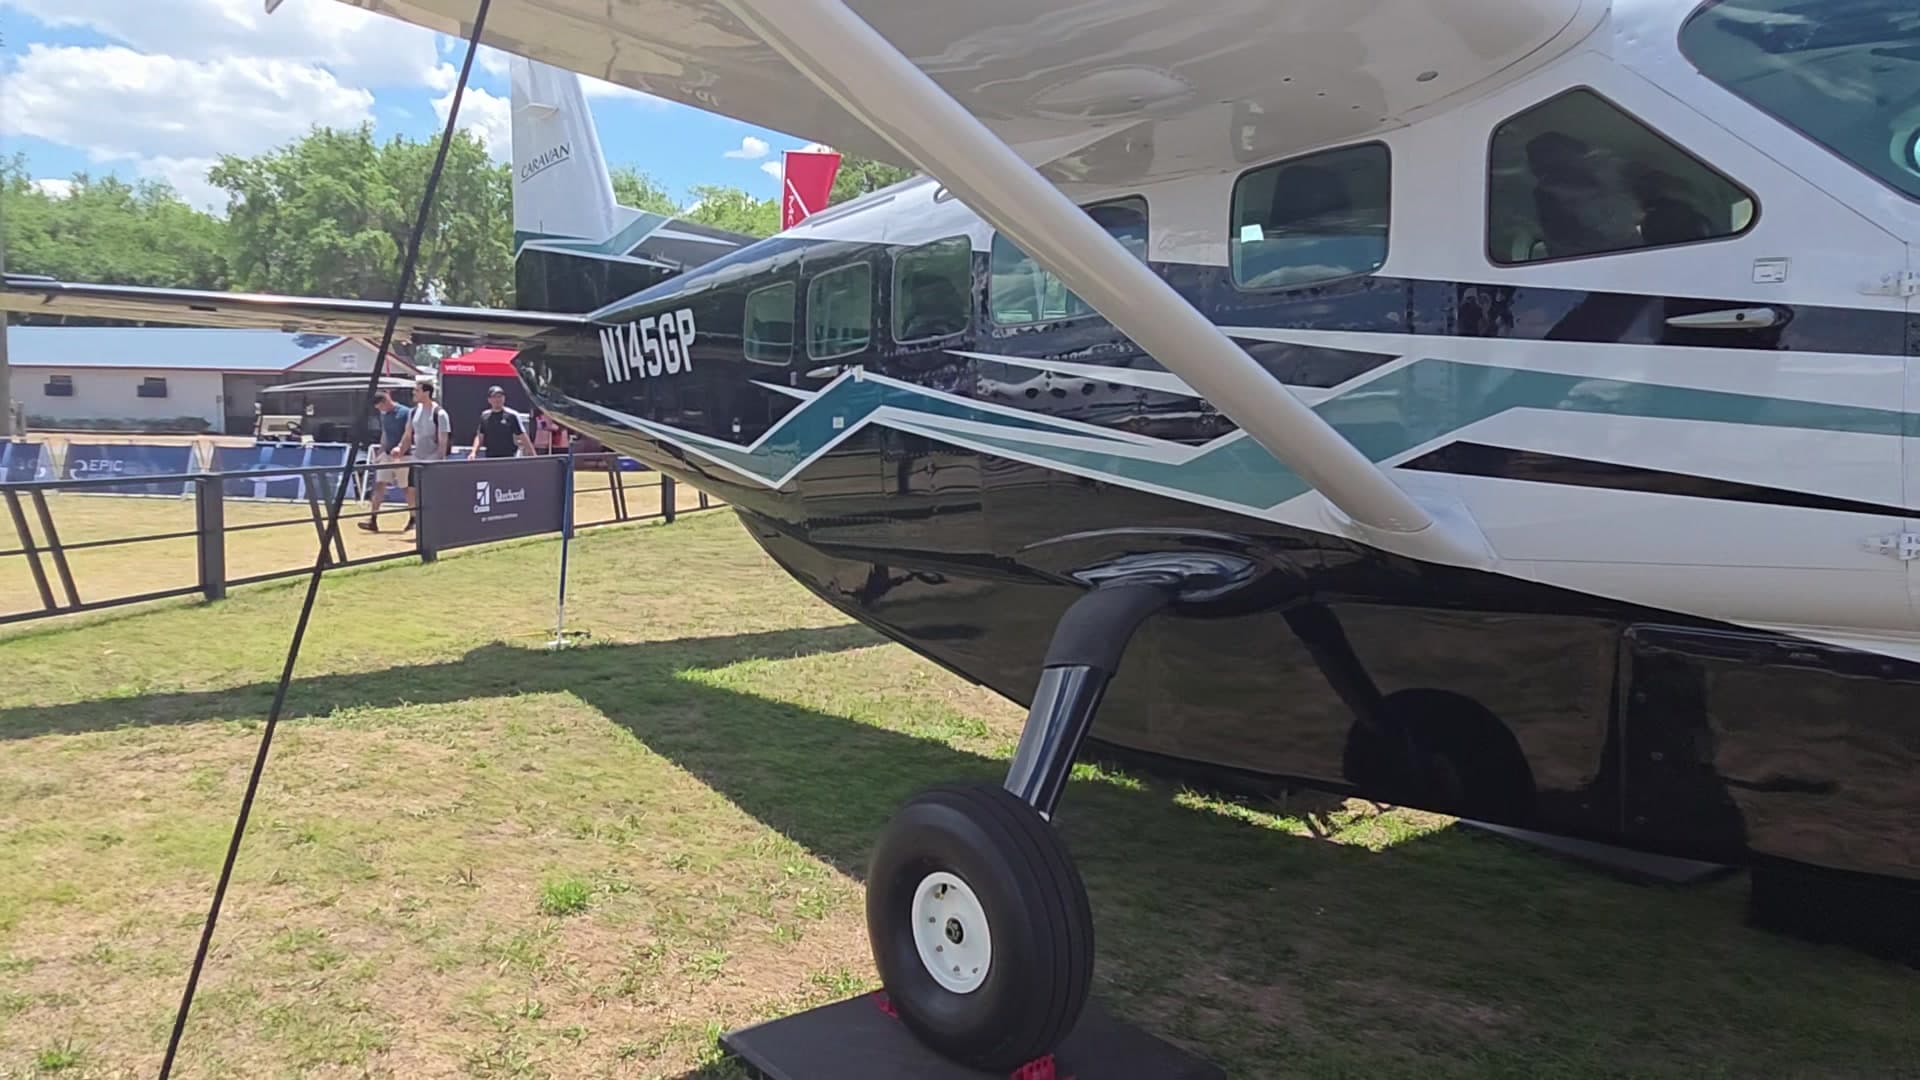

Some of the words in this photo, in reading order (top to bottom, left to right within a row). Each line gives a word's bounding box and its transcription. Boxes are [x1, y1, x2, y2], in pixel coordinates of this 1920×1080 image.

[521, 142, 570, 178] CARAVAN
[599, 308, 695, 384] N145GP
[89, 459, 123, 472] EPIC
